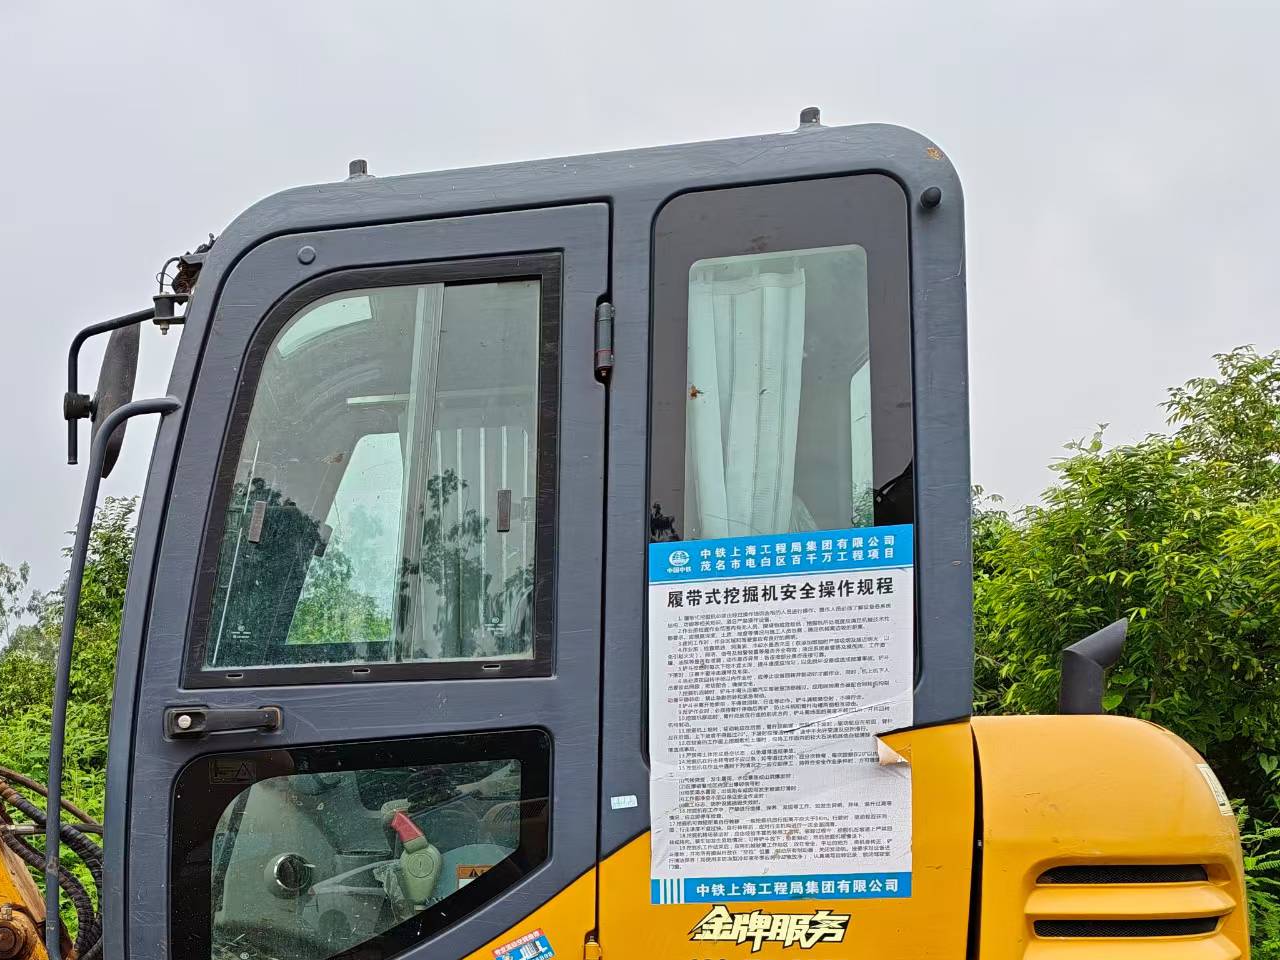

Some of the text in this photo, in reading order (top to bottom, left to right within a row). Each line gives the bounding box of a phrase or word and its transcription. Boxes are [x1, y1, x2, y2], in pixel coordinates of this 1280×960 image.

[700, 535, 895, 559] 中铁上海工程局集团有限公司
[700, 548, 895, 571] 茂名市电白区百千万工程项目
[667, 577, 894, 608] 履带式挖掘机安全操作规程
[696, 879, 898, 897] 中铁上海工程局集团有限公司
[688, 904, 851, 953] 金牌服务
